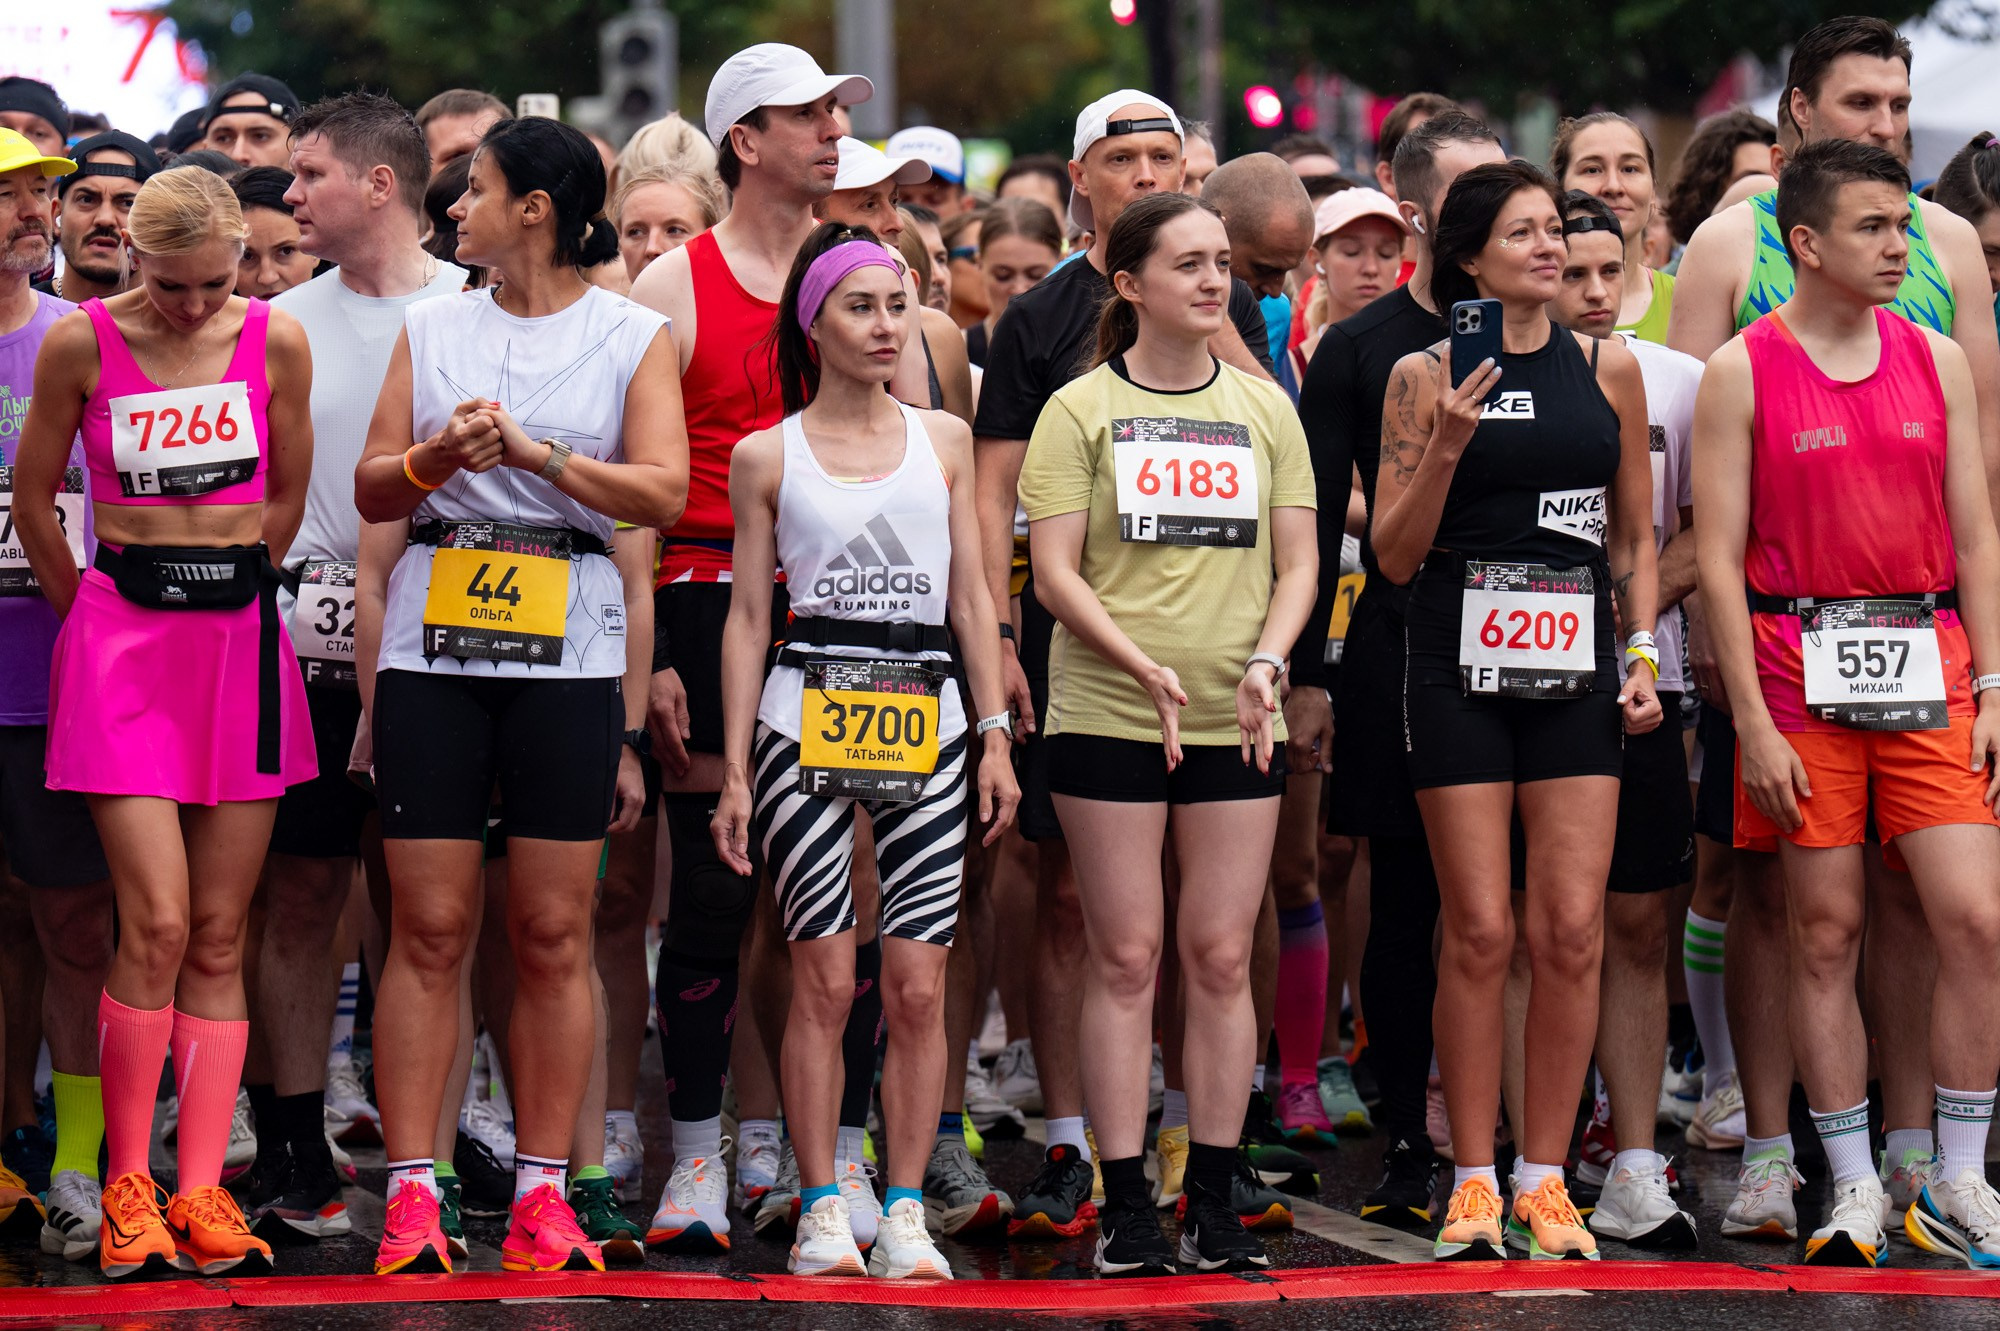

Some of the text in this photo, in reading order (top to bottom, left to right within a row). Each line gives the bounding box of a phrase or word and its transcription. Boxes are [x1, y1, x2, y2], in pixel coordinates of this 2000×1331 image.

[1482, 398, 1532, 413] KE
[129, 402, 239, 452] 7266
[1179, 431, 1234, 446] 15 KM
[138, 472, 152, 491] F
[1136, 458, 1239, 500] 6183
[1542, 494, 1601, 518] NIKE
[532, 532, 551, 540] FEST
[1139, 516, 1152, 536] F
[1581, 518, 1606, 538] PR
[494, 539, 550, 558] 15 KM
[466, 563, 522, 607] 44
[814, 566, 932, 599] adidas
[1530, 581, 1579, 594] 15 KM
[470, 607, 513, 622] ОЛЬГА
[834, 600, 911, 611] RUNNING
[314, 597, 355, 638] 32
[1868, 615, 1918, 629] 15 KM
[1480, 608, 1579, 651] 6209
[434, 629, 447, 651] F
[1837, 640, 1910, 679] 557
[307, 661, 322, 683] F
[1478, 667, 1493, 688] F
[874, 681, 925, 696] 15 KM
[1850, 683, 1903, 694] МИХАИЛ
[821, 703, 925, 747] 3700
[844, 748, 904, 762] ТАТЬЯНА
[813, 771, 829, 792] F
